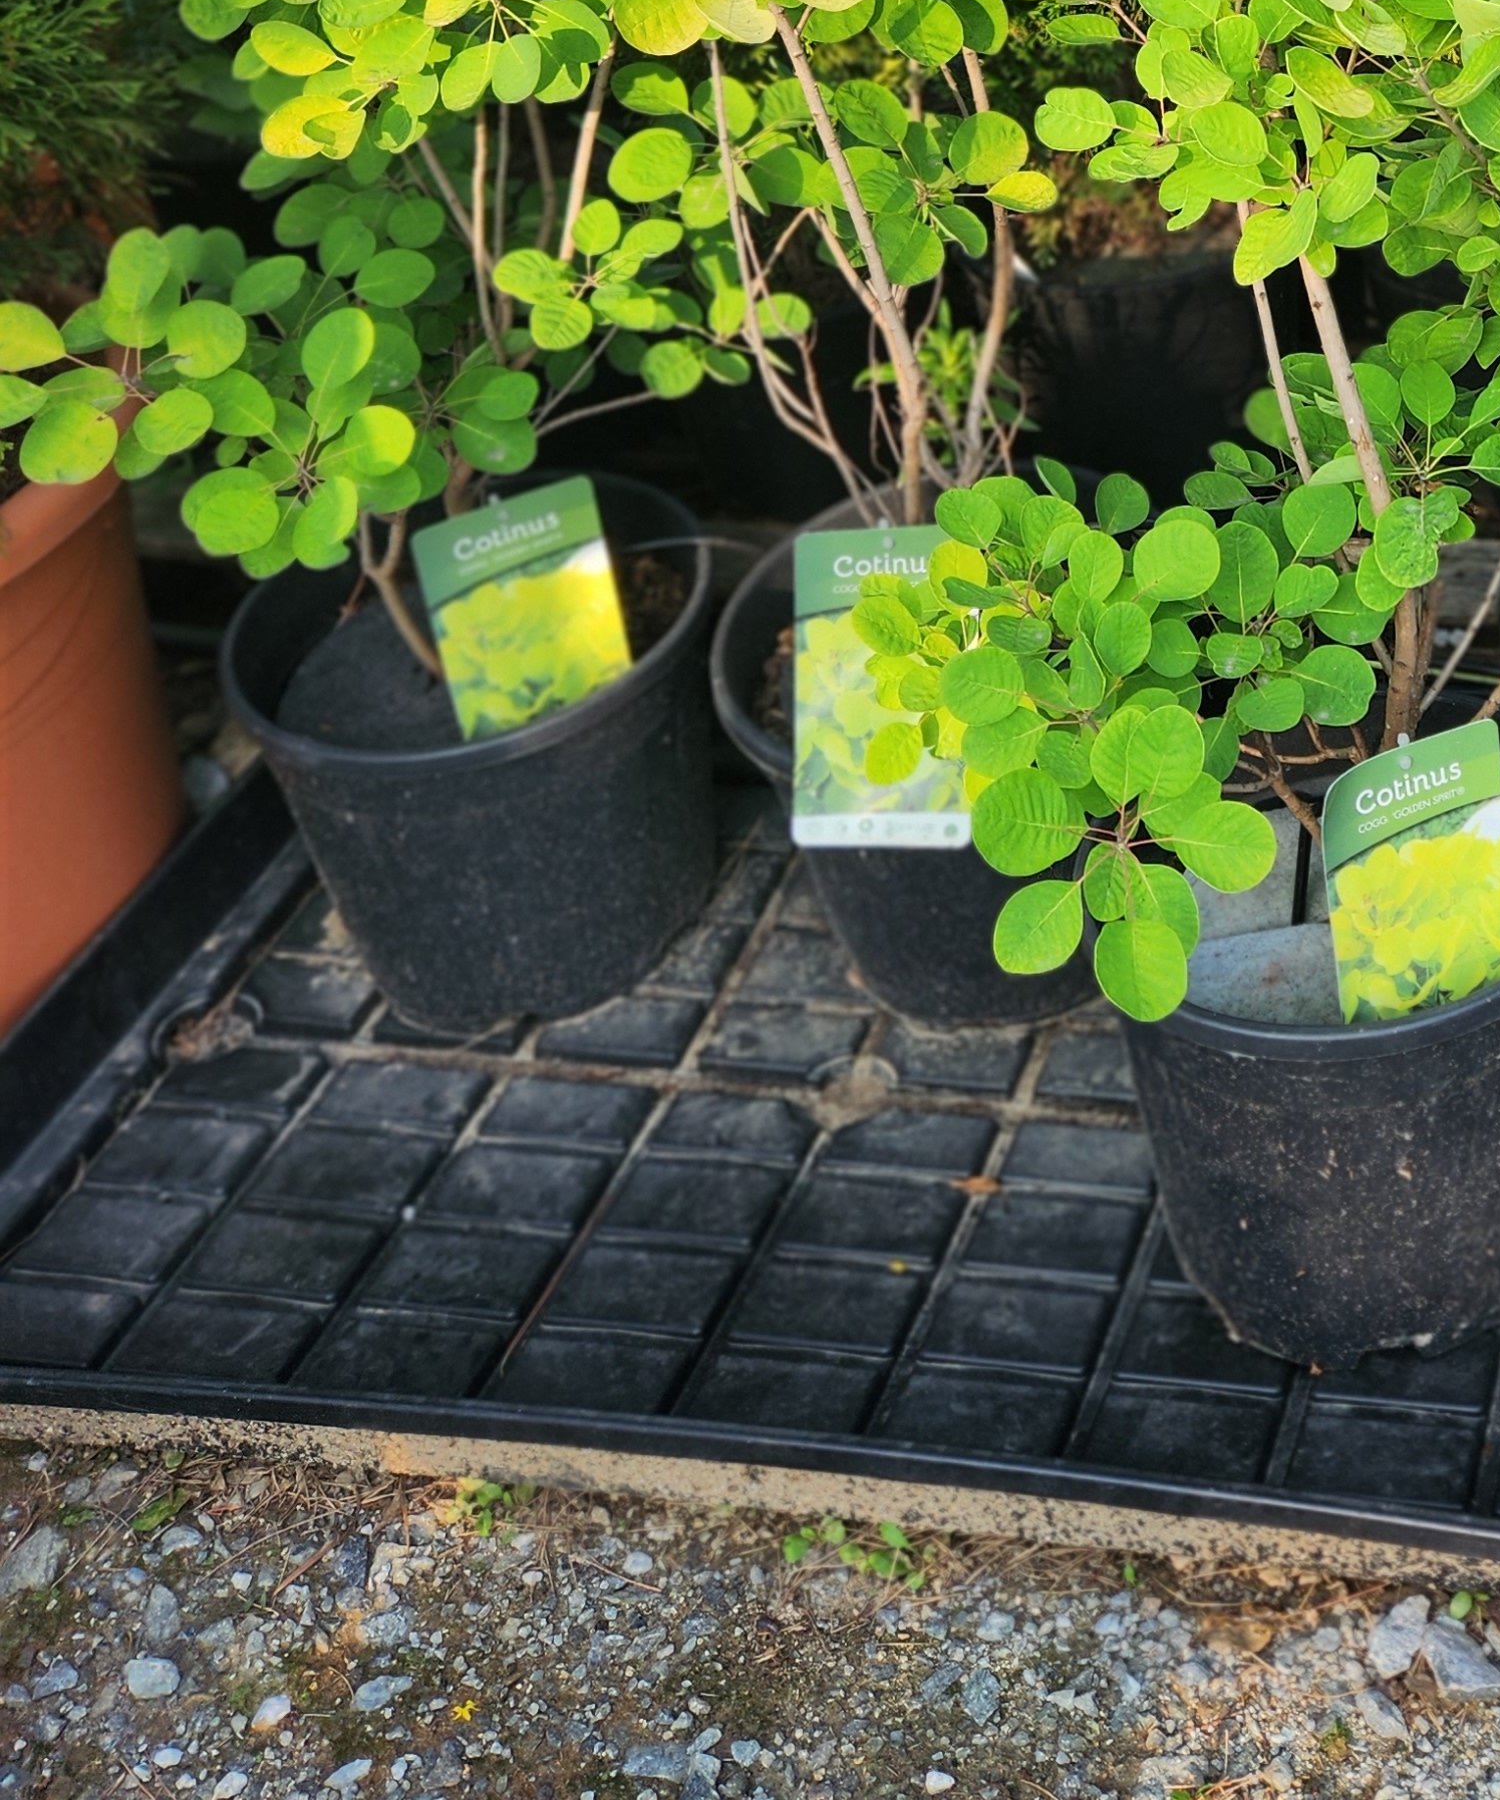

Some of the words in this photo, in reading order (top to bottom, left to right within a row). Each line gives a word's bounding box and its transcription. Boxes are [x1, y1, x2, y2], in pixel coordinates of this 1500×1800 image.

[453, 512, 560, 560] Cotinus
[833, 553, 929, 577] Cotinu
[1355, 762, 1462, 815] Cotinus
